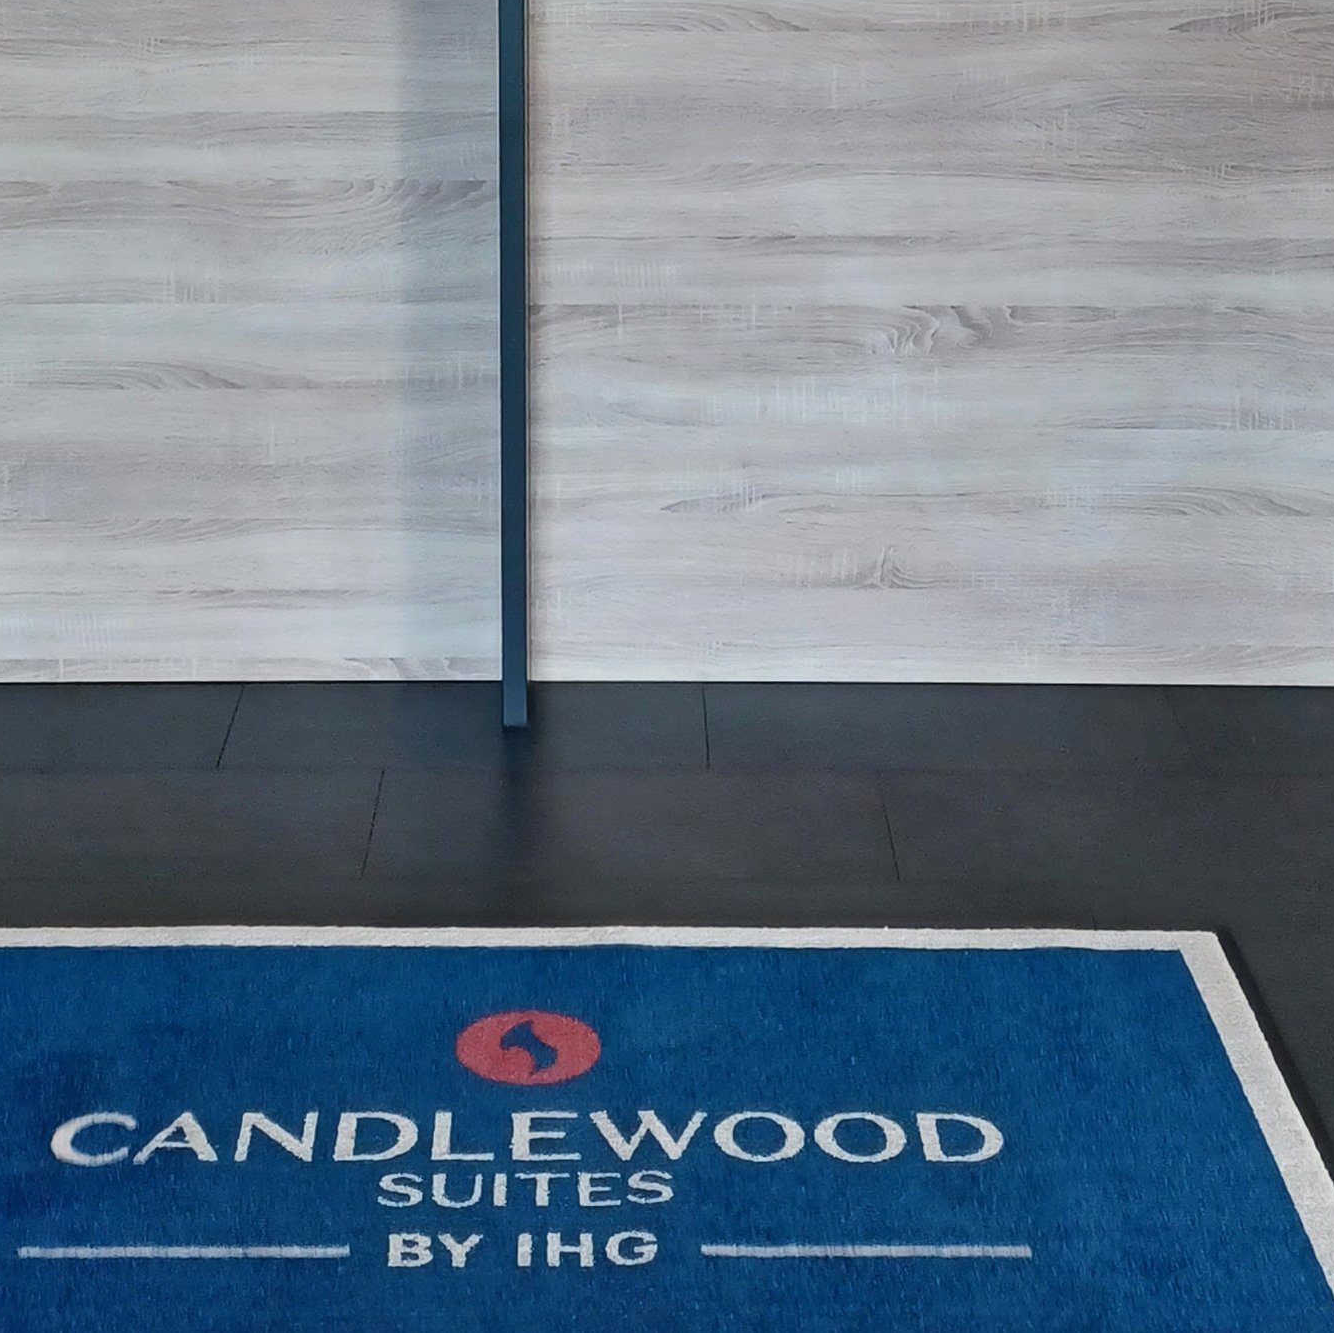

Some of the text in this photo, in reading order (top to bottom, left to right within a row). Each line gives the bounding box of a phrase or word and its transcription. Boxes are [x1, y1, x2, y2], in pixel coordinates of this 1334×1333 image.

[49, 1109, 1004, 1167] CANDLEWOOD
[376, 1170, 676, 1208] SUITES
[386, 1230, 659, 1268] BY IHG
